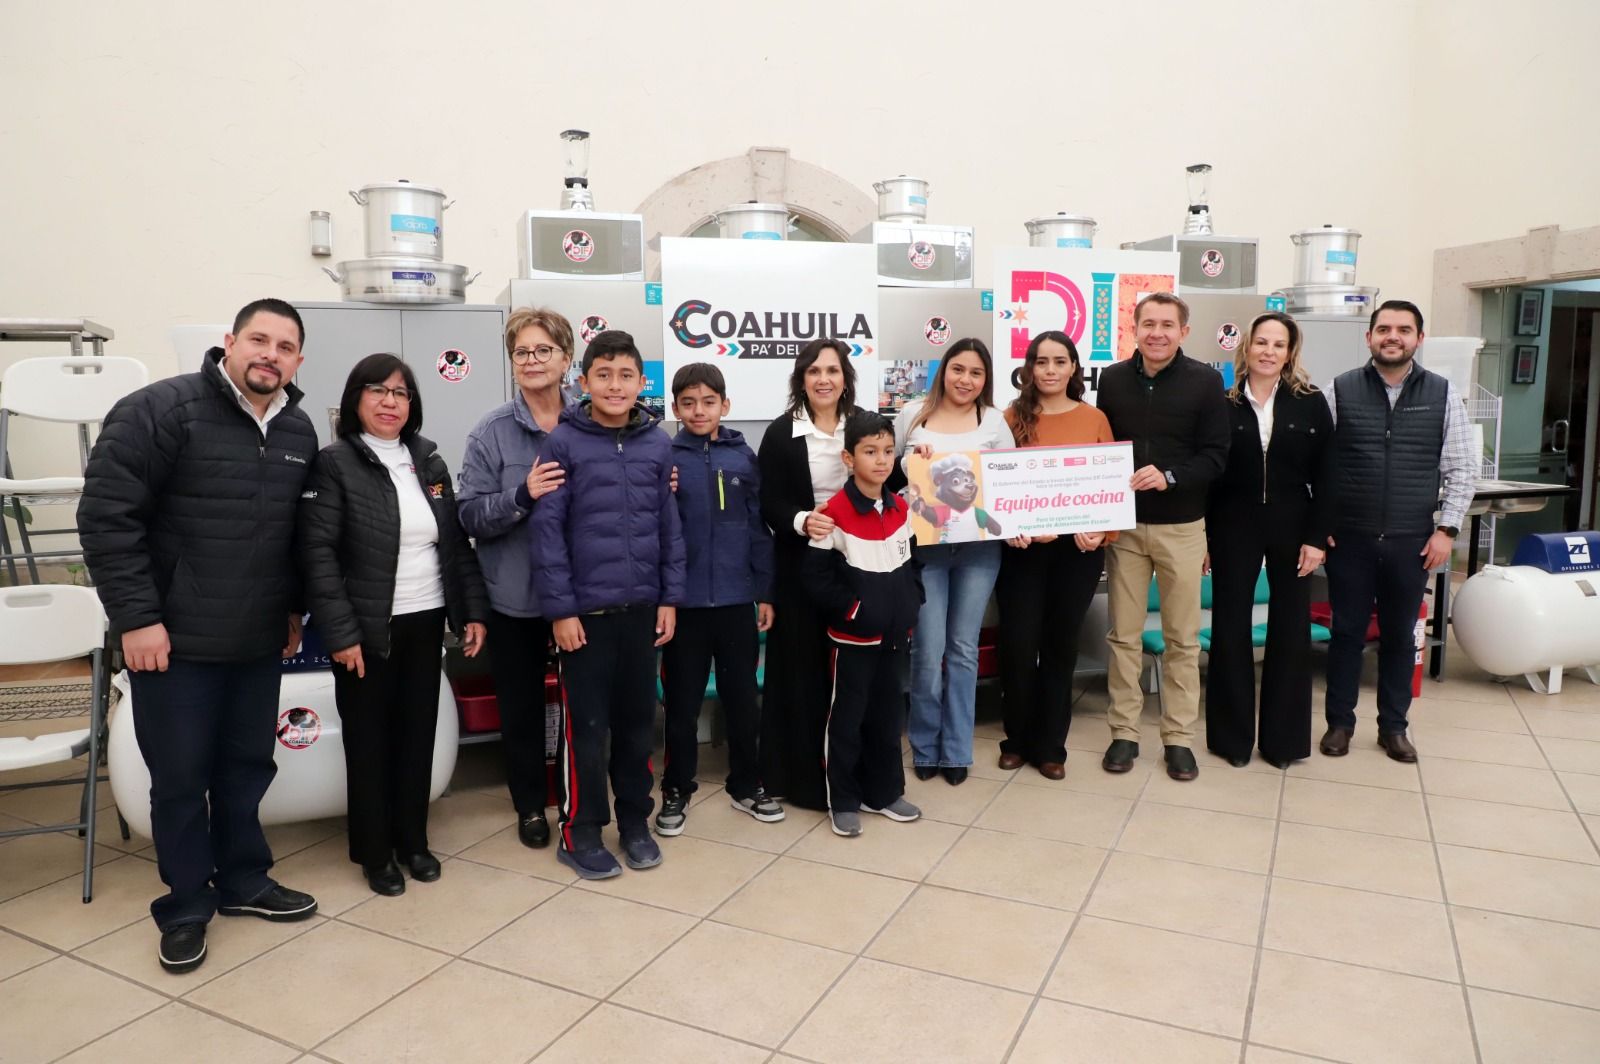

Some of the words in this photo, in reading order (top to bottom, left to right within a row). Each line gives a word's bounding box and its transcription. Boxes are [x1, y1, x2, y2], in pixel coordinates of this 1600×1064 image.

[669, 300, 873, 348] COAHUILA
[776, 344, 800, 356] DEL
[994, 494, 1049, 514] Equipo
[1051, 493, 1070, 508] de
[1072, 490, 1125, 506] cocina
